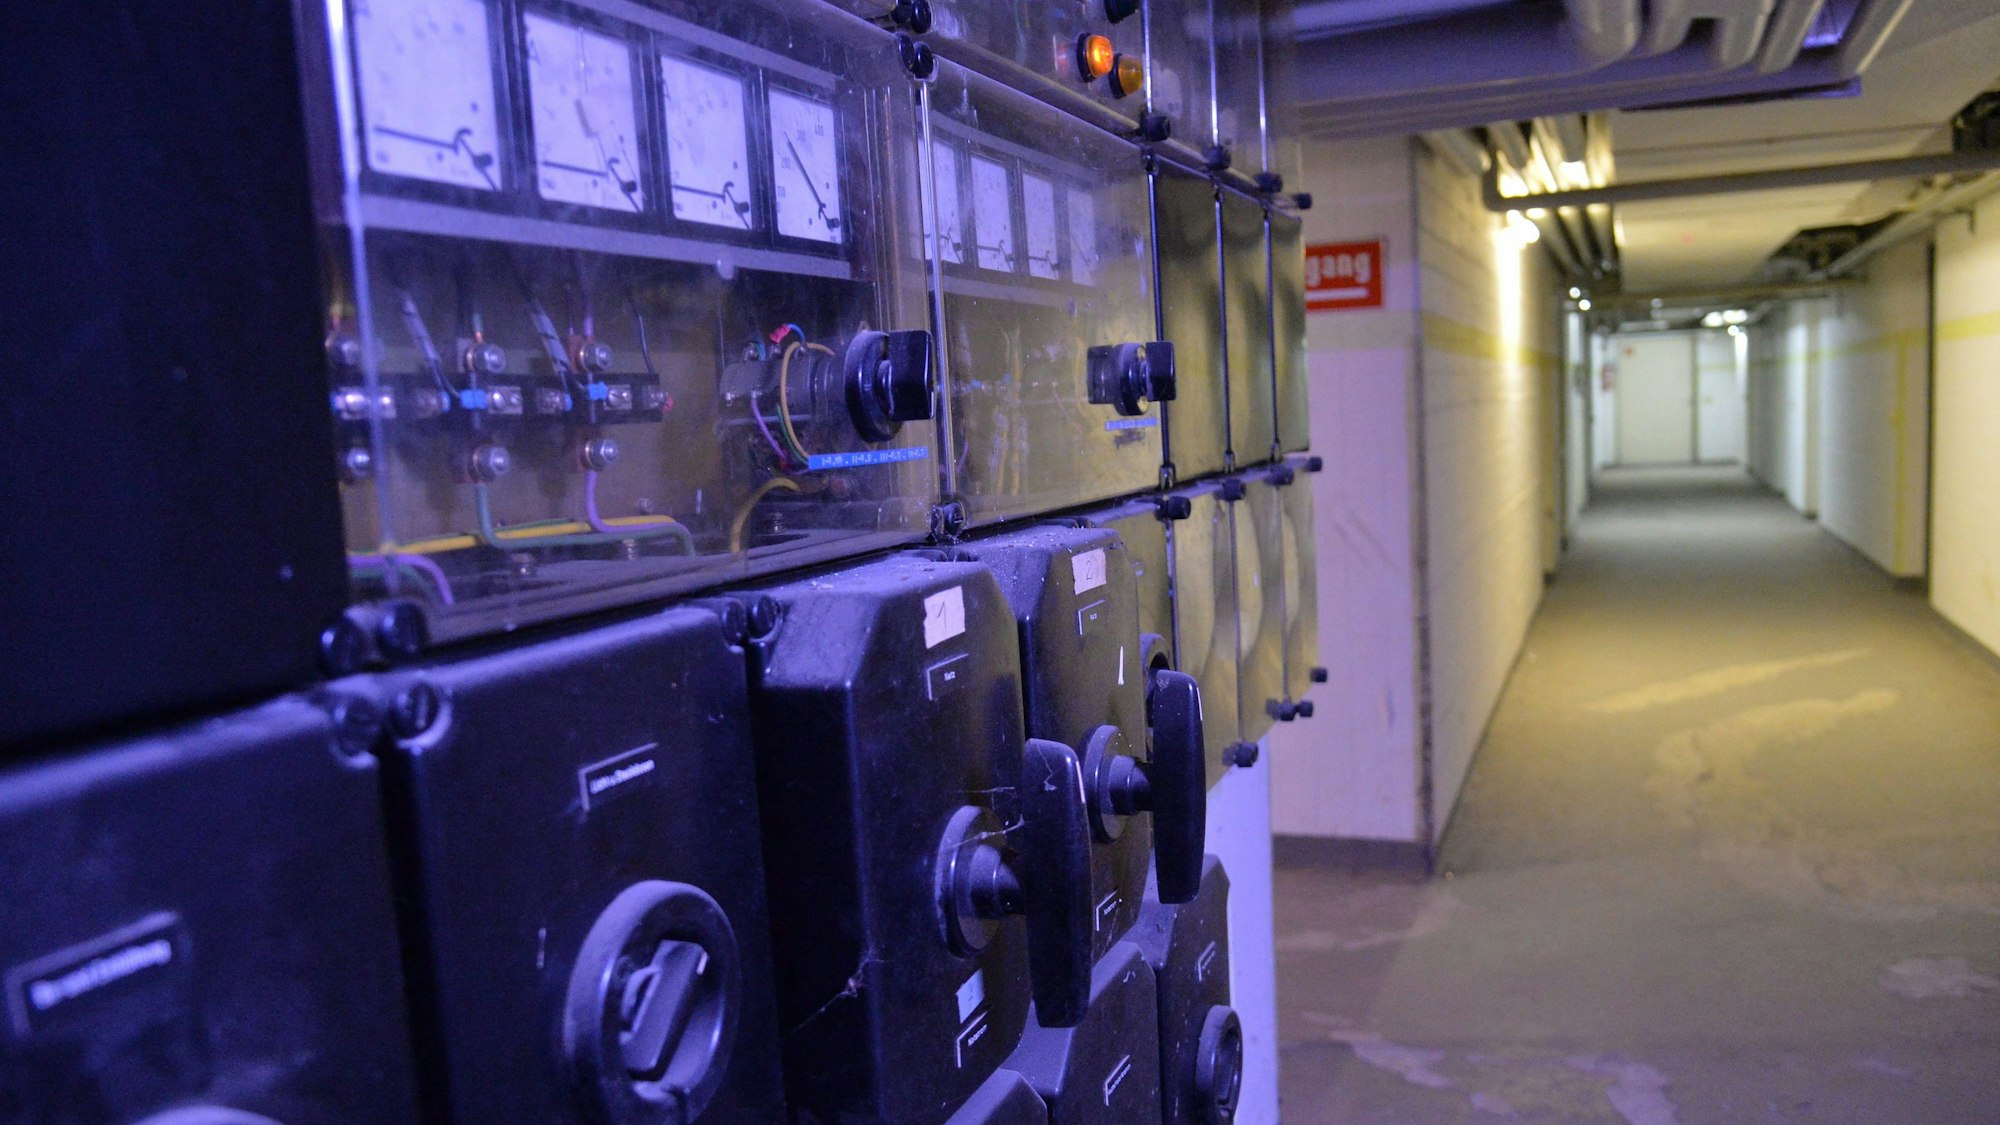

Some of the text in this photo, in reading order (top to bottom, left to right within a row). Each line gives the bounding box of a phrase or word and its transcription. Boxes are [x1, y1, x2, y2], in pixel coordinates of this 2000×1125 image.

[1305, 252, 1370, 287] gang
[1085, 559, 1093, 581] 2
[936, 600, 947, 630] 1
